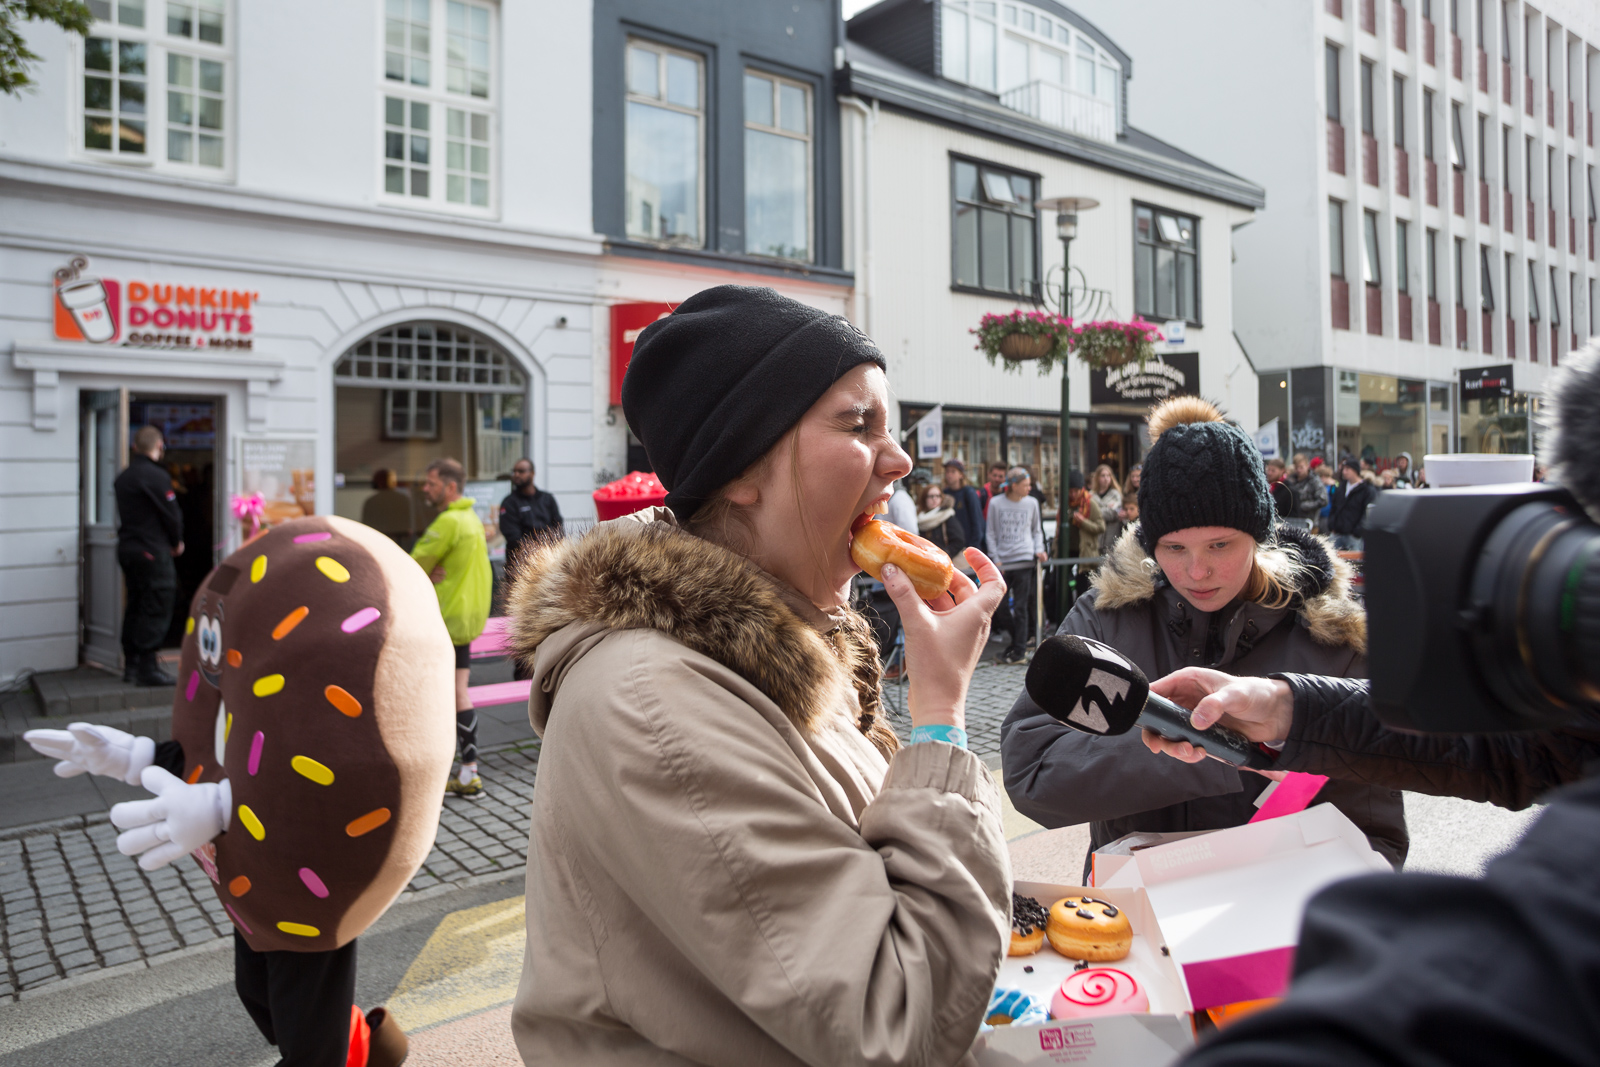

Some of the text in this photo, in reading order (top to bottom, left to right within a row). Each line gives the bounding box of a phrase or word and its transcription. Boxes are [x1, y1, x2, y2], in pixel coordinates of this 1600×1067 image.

[129, 281, 259, 310] DUNKIN'
[129, 306, 253, 334] DONUTS
[129, 332, 254, 349] COFFEE & MORE
